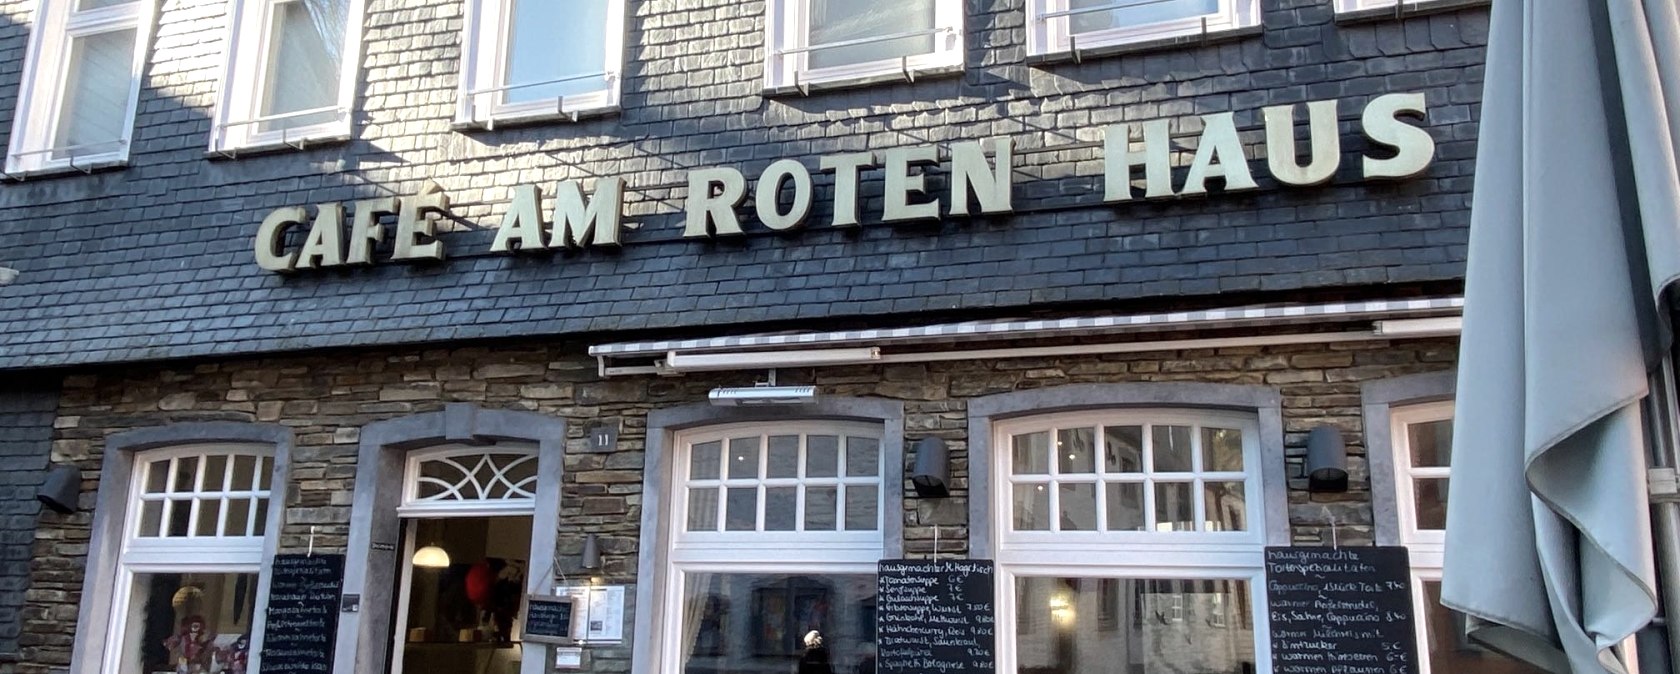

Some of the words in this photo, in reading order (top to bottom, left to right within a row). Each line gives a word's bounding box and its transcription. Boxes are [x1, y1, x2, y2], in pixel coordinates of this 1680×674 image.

[254, 178, 449, 272] CAFÉ
[490, 176, 626, 252] AM
[683, 136, 1014, 239] ROTEN
[1102, 92, 1434, 202] HAUS
[598, 433, 609, 447] 11
